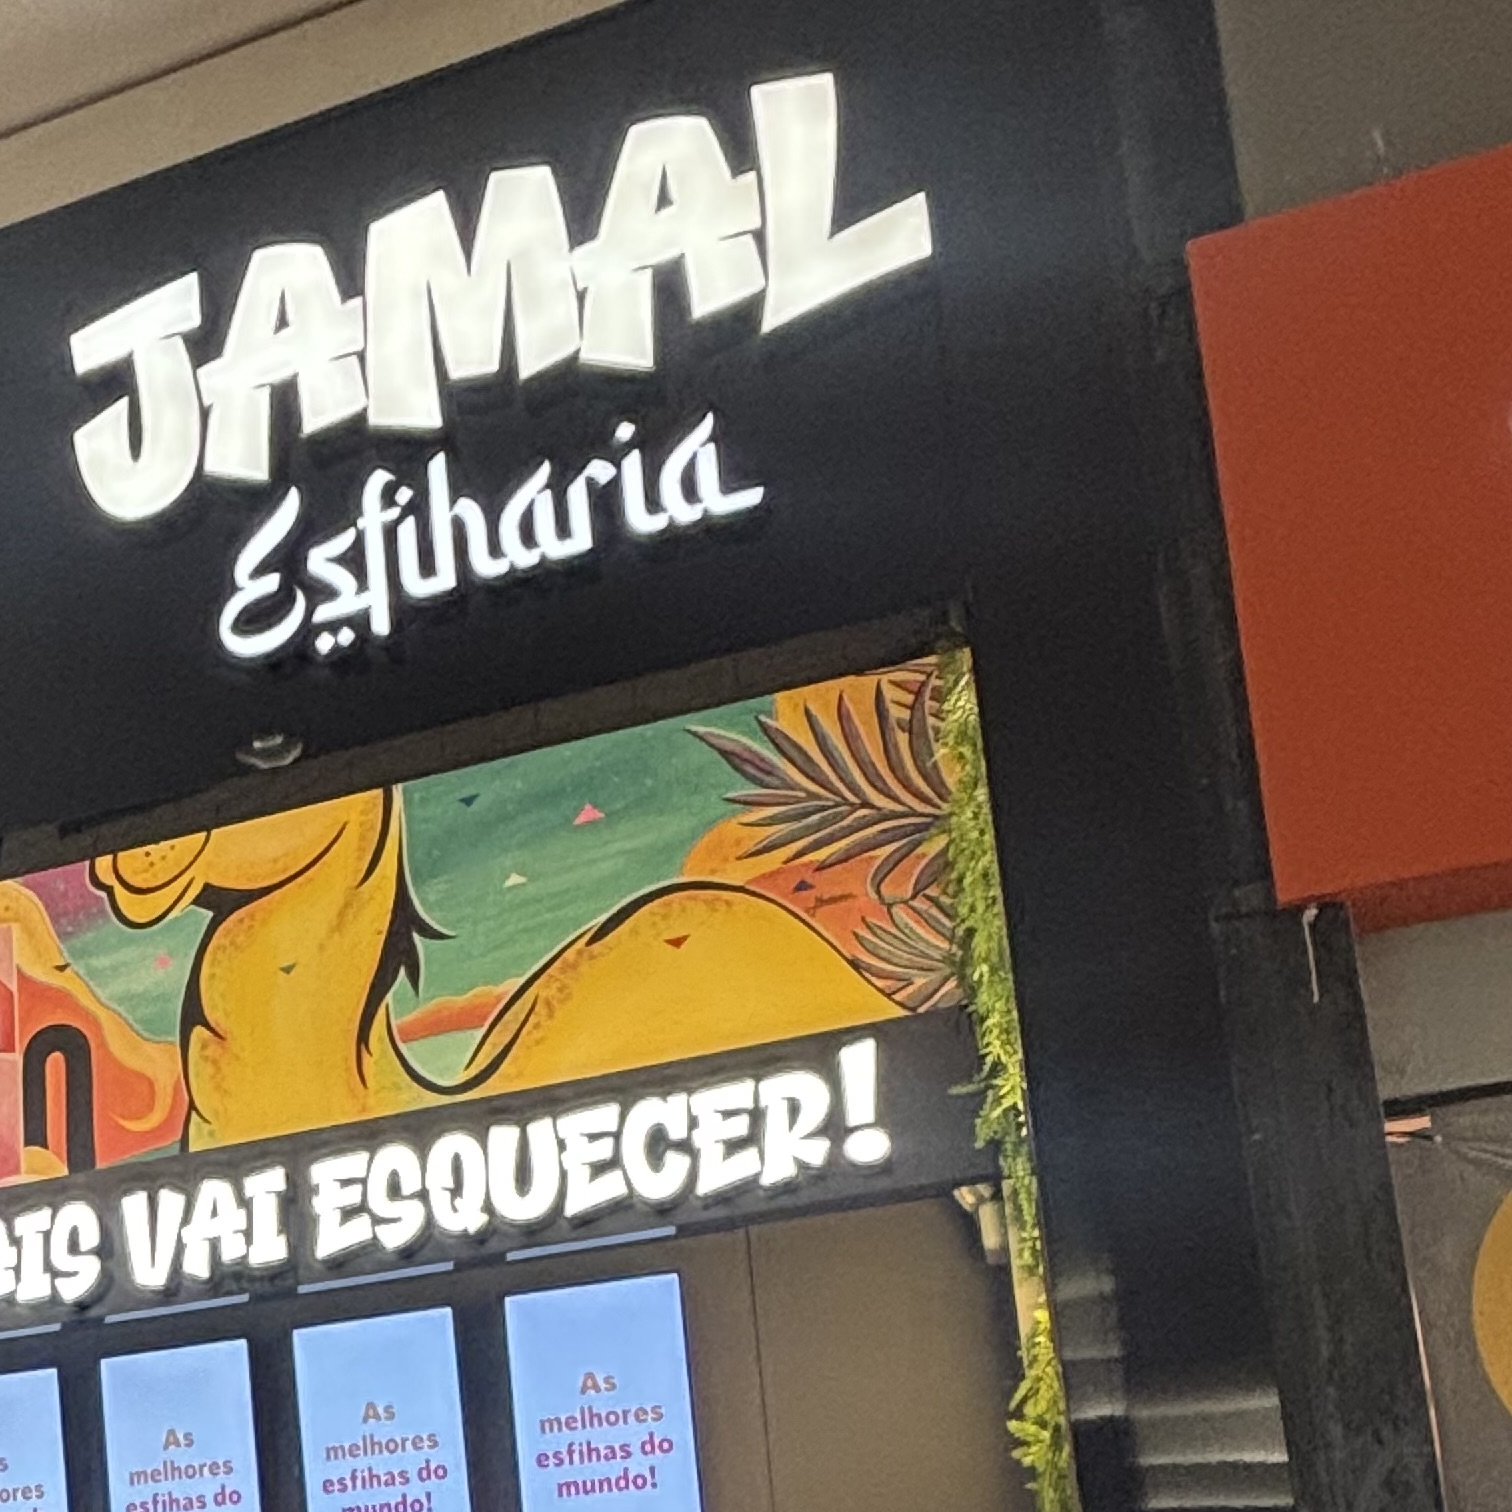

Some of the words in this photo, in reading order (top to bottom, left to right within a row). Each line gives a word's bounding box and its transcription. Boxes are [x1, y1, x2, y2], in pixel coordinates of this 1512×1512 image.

[69, 71, 934, 521] JAMAL
[217, 411, 766, 658] Esfiharia
[121, 1166, 287, 1289] VAI
[309, 1038, 891, 1261] ESQUECER!
[580, 1372, 617, 1395] As
[361, 1402, 395, 1423] As
[539, 1404, 664, 1434] melhores
[163, 1429, 194, 1451] As
[325, 1432, 439, 1461] melhores
[536, 1440, 632, 1468] esfihas
[640, 1431, 673, 1456] do
[129, 1457, 233, 1486] melhores
[322, 1466, 410, 1495] esfihas
[417, 1459, 448, 1483] do
[557, 1466, 658, 1497] mundo!
[213, 1484, 241, 1507] do
